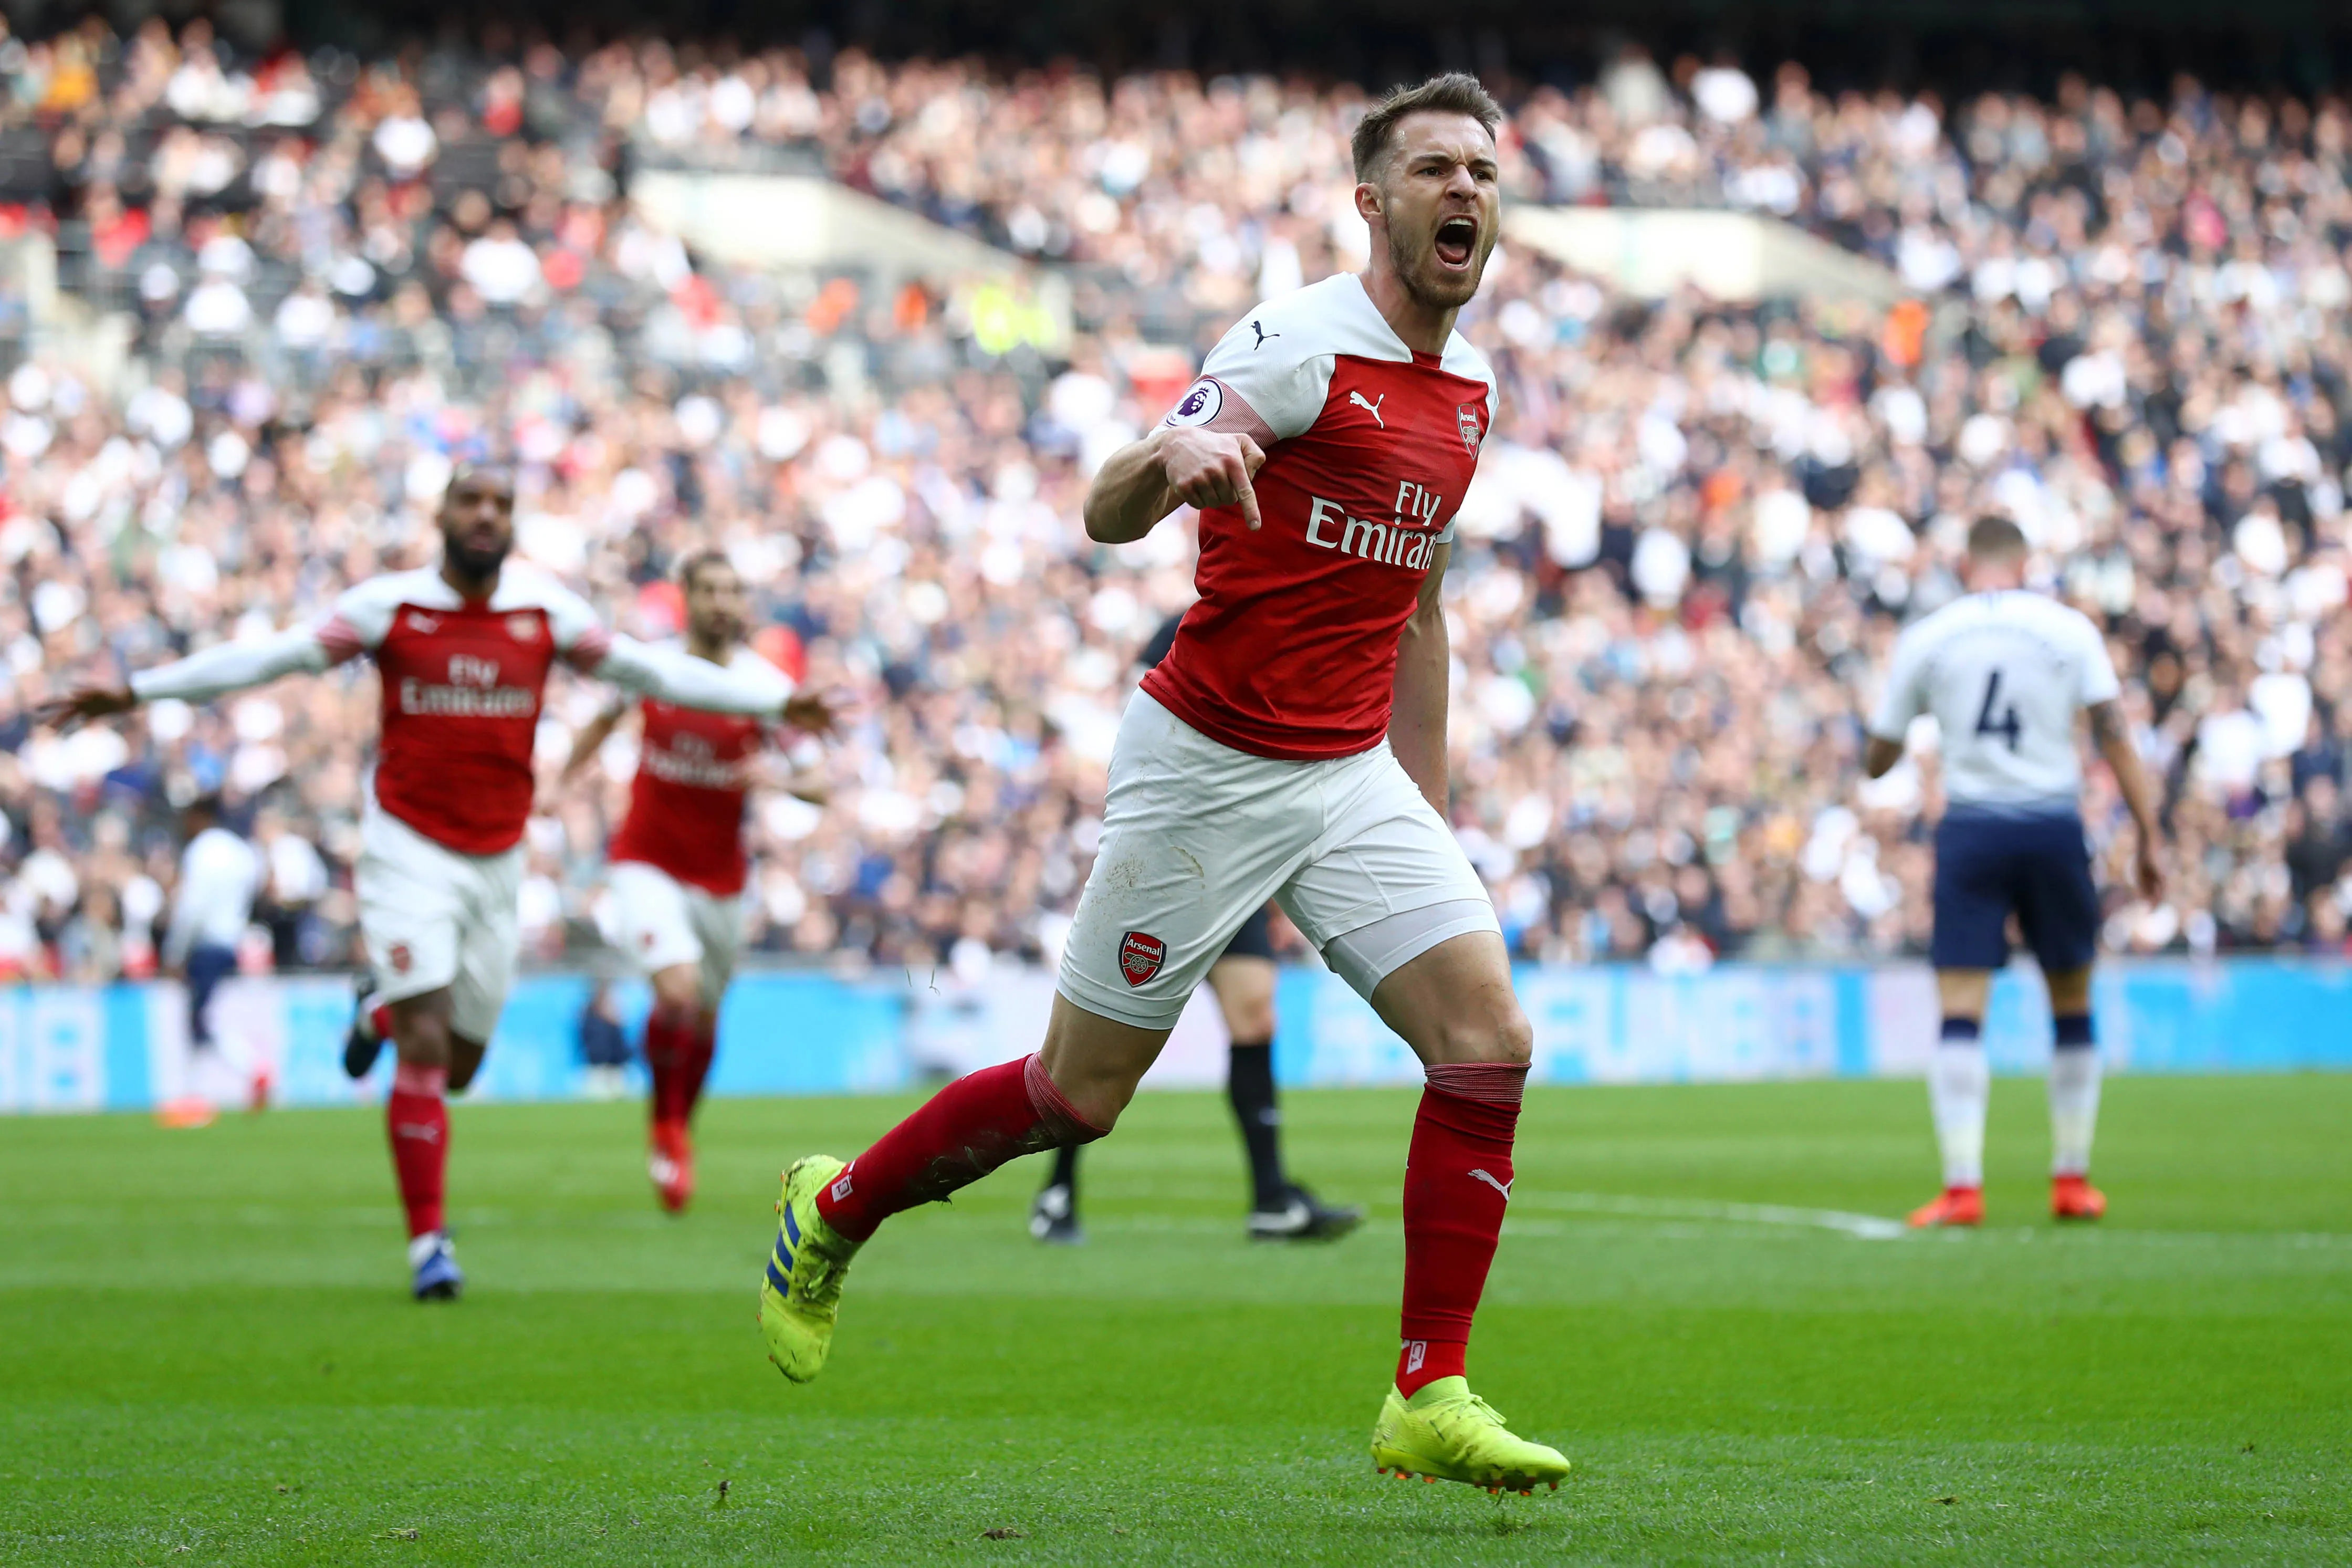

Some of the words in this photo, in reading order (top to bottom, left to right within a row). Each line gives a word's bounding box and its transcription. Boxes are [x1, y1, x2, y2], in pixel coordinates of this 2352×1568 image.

[1305, 495, 1439, 570] Emirat
[1395, 480, 1441, 526] Fly
[1974, 667, 2022, 755] 4
[1127, 938, 1160, 956] Arsenal
